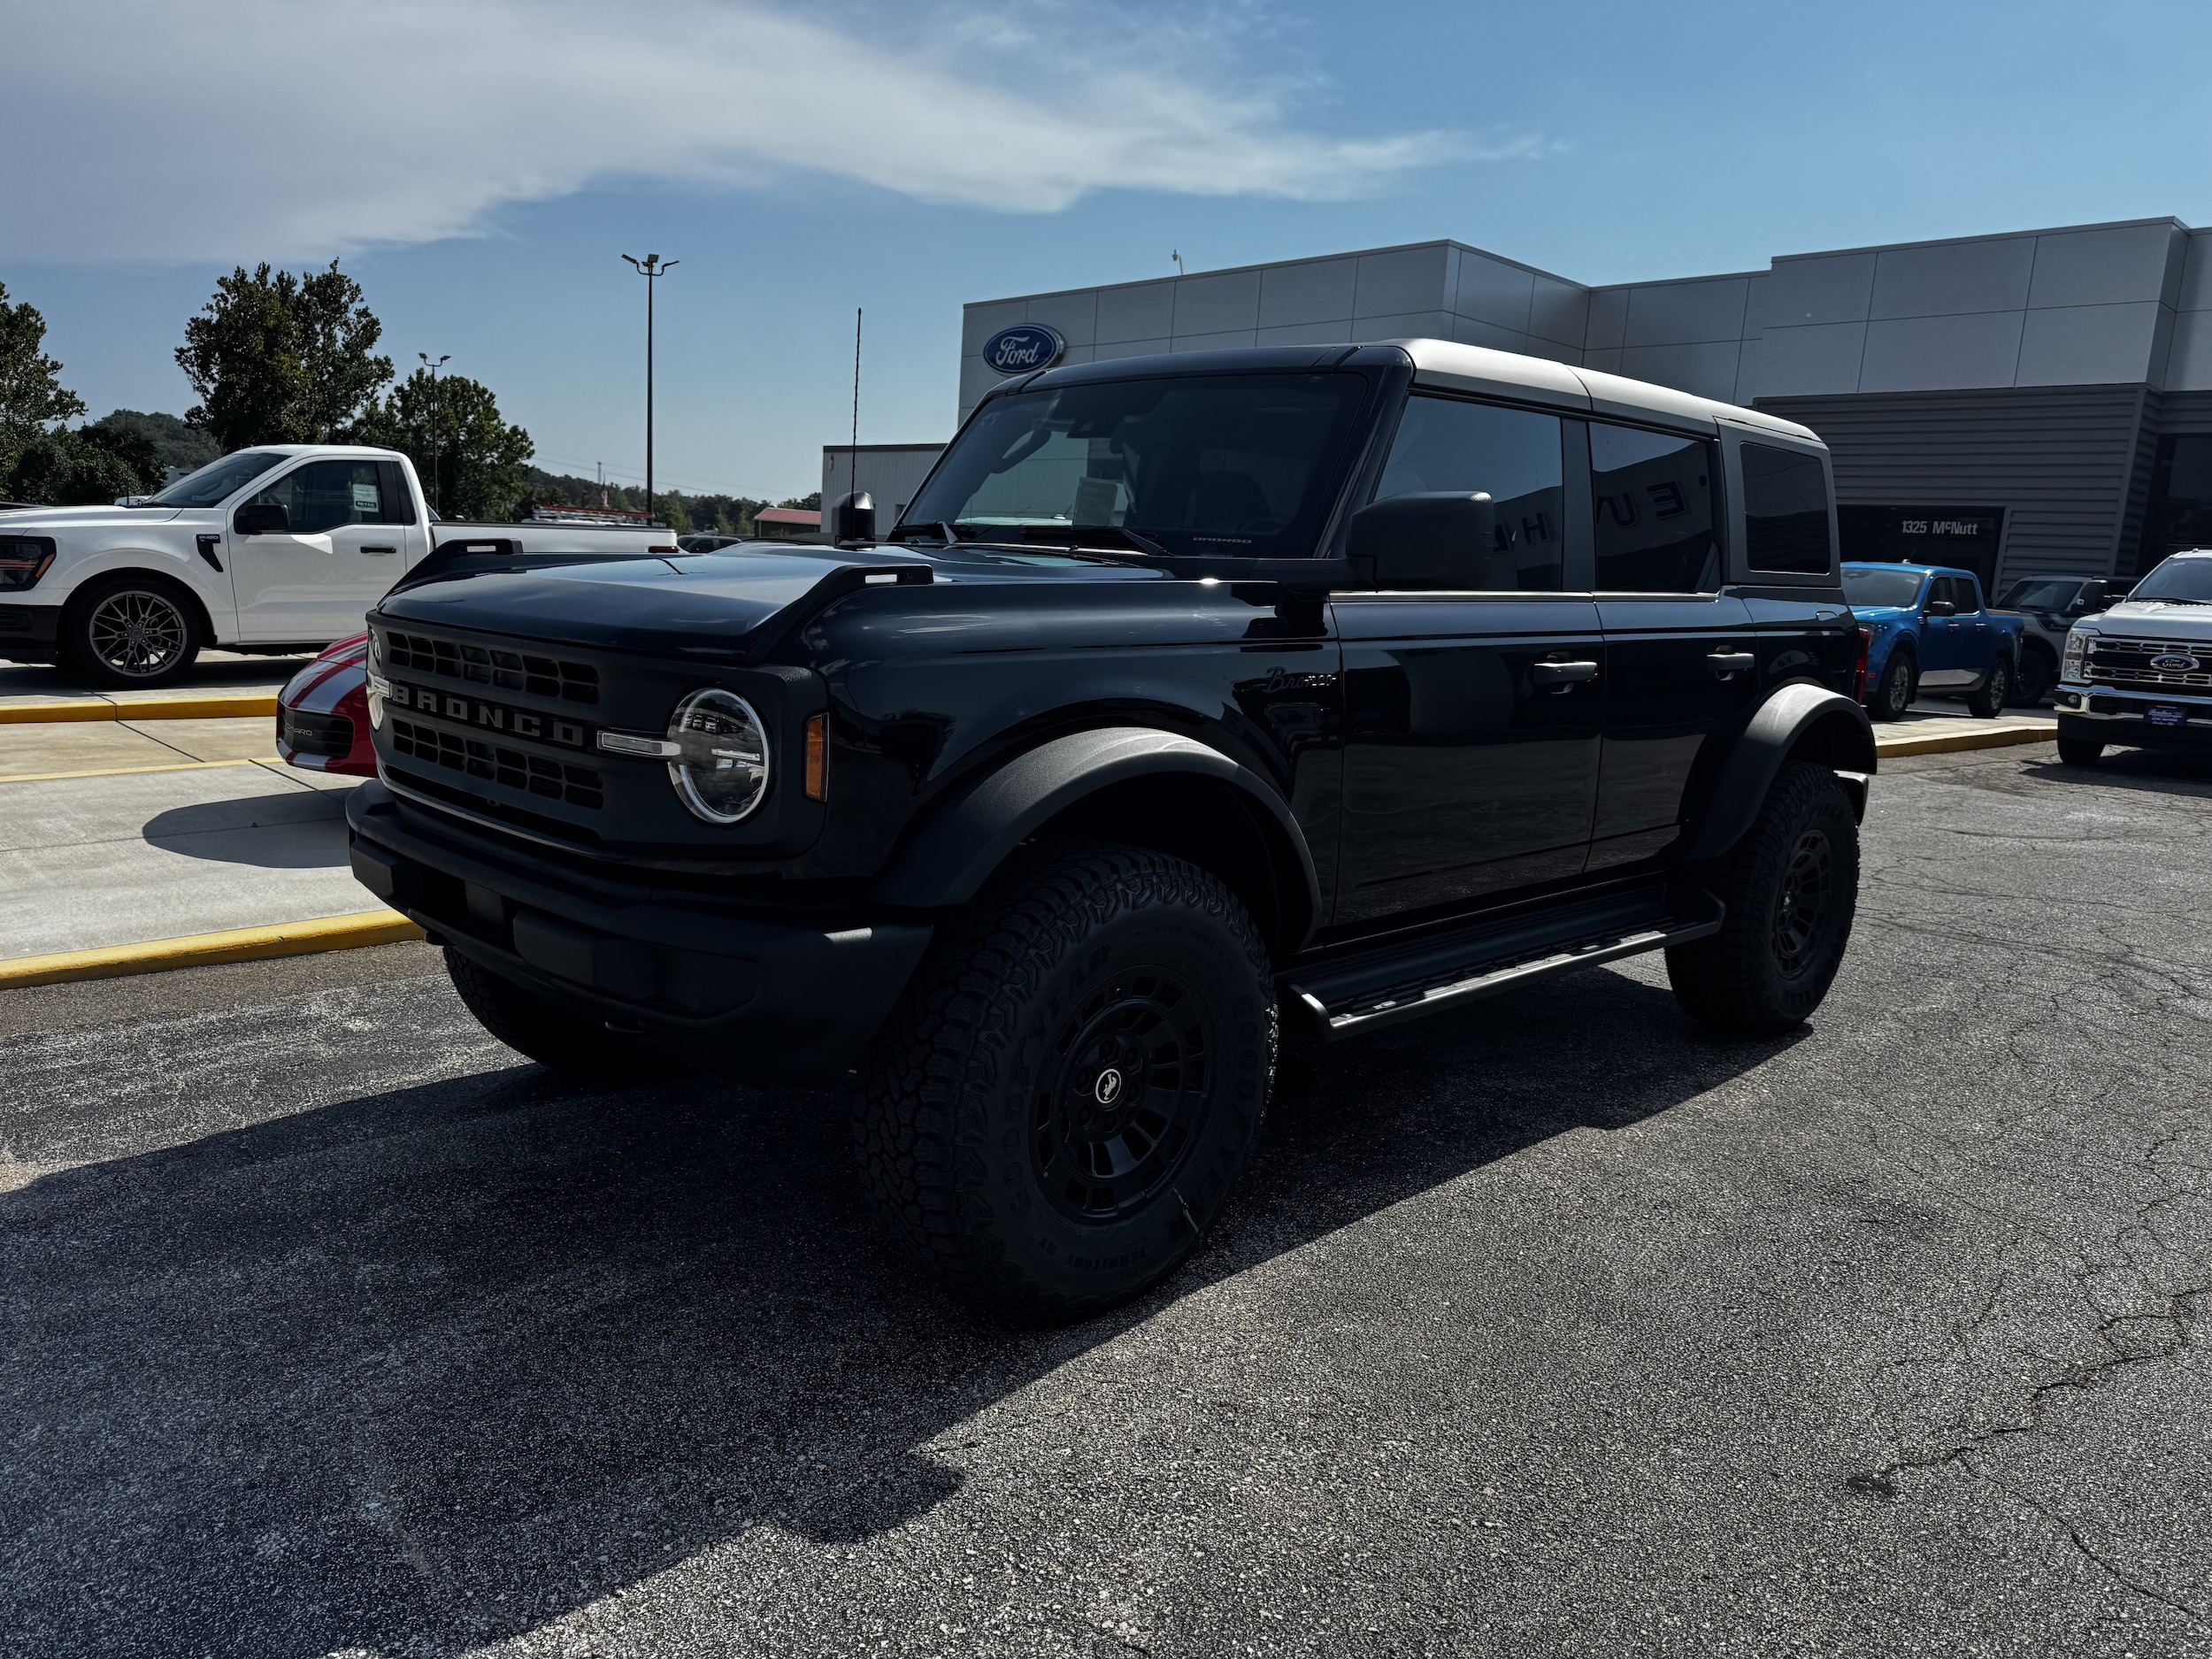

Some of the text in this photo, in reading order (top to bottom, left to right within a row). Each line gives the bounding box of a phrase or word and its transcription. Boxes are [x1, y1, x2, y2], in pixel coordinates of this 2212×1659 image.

[995, 335, 1041, 366] Ford
[1901, 520, 1979, 535] 1325 McNutt
[2162, 658, 2186, 669] Ford
[1262, 665, 1337, 694] Bronco
[391, 682, 584, 747] BRONCO
[1064, 1247, 1148, 1271] TERRITORY
